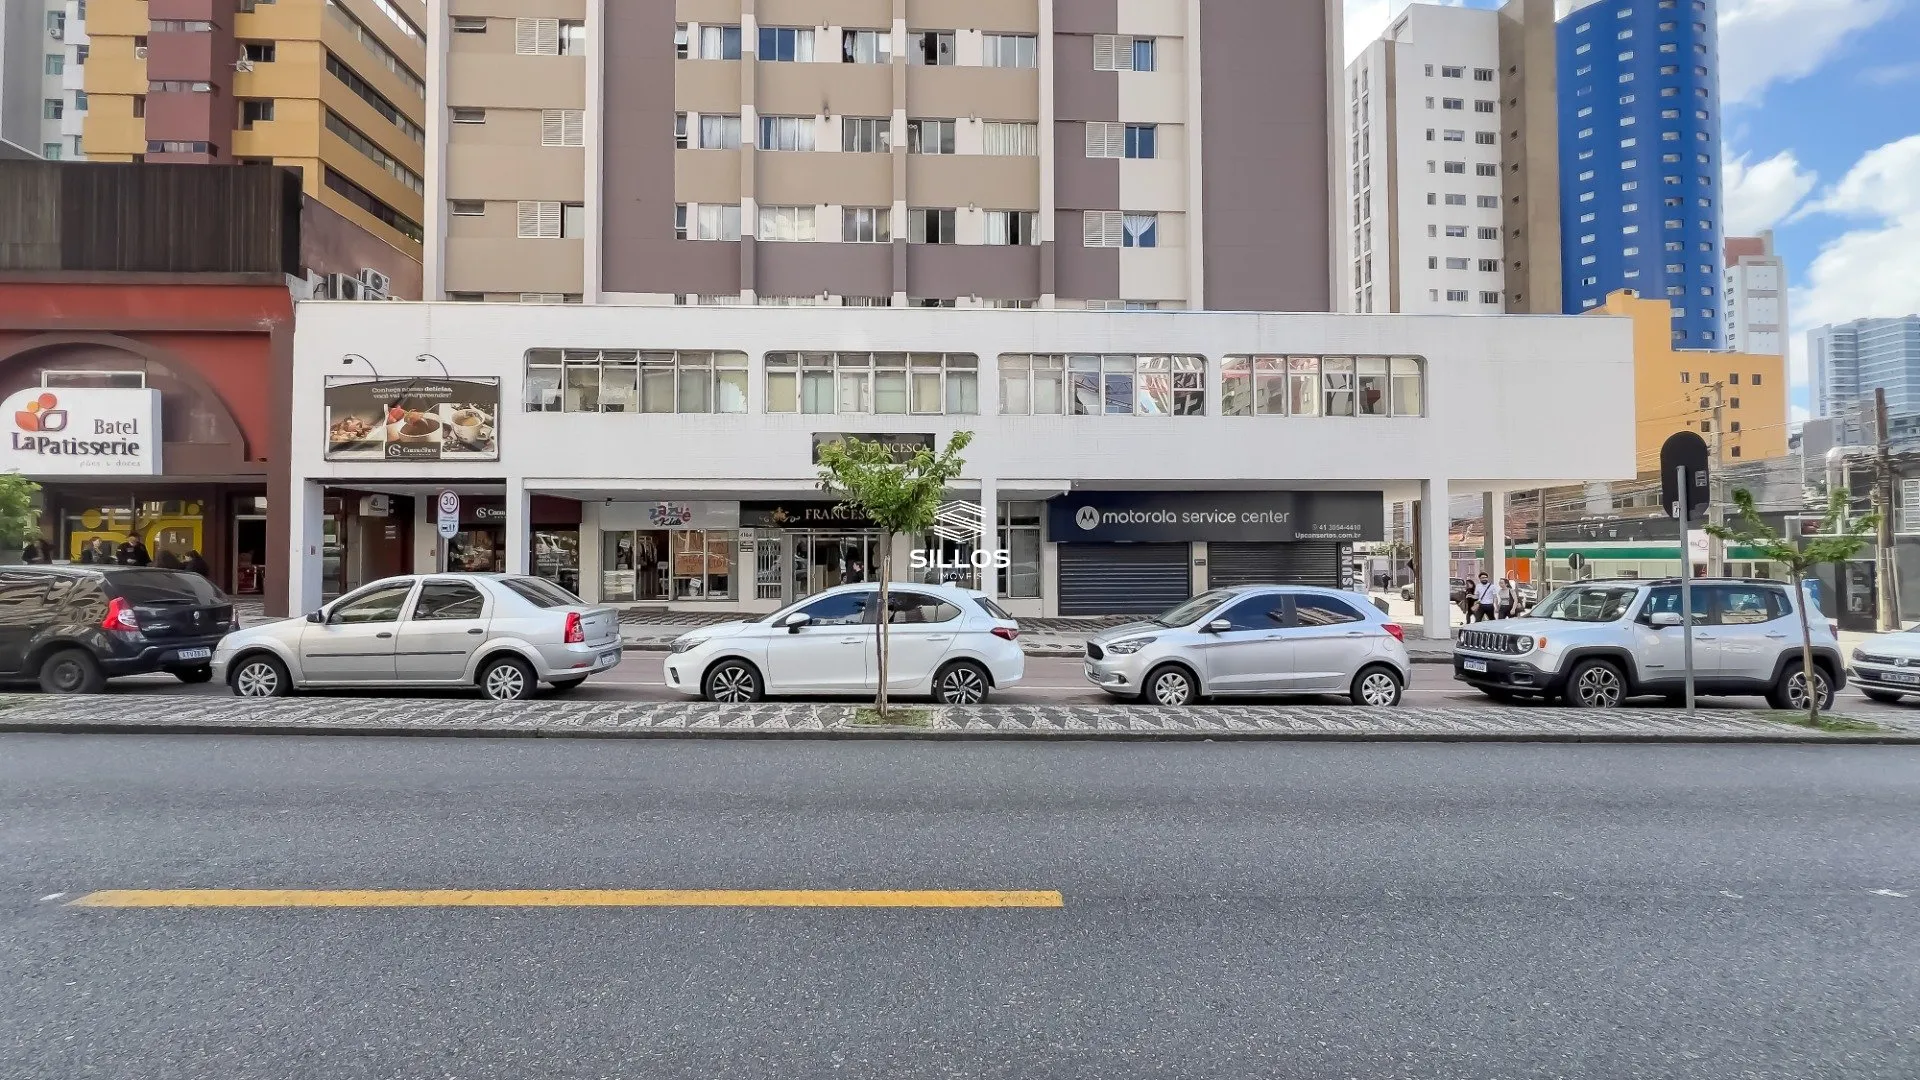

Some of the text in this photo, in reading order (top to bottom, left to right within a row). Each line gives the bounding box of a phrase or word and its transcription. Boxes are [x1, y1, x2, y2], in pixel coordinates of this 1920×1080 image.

[94, 418, 138, 435] Batel
[443, 496, 455, 505] 30
[805, 508, 874, 520] FRANCESC
[1102, 509, 1177, 524] motorola
[1182, 508, 1236, 523] service
[1241, 510, 1290, 523] center
